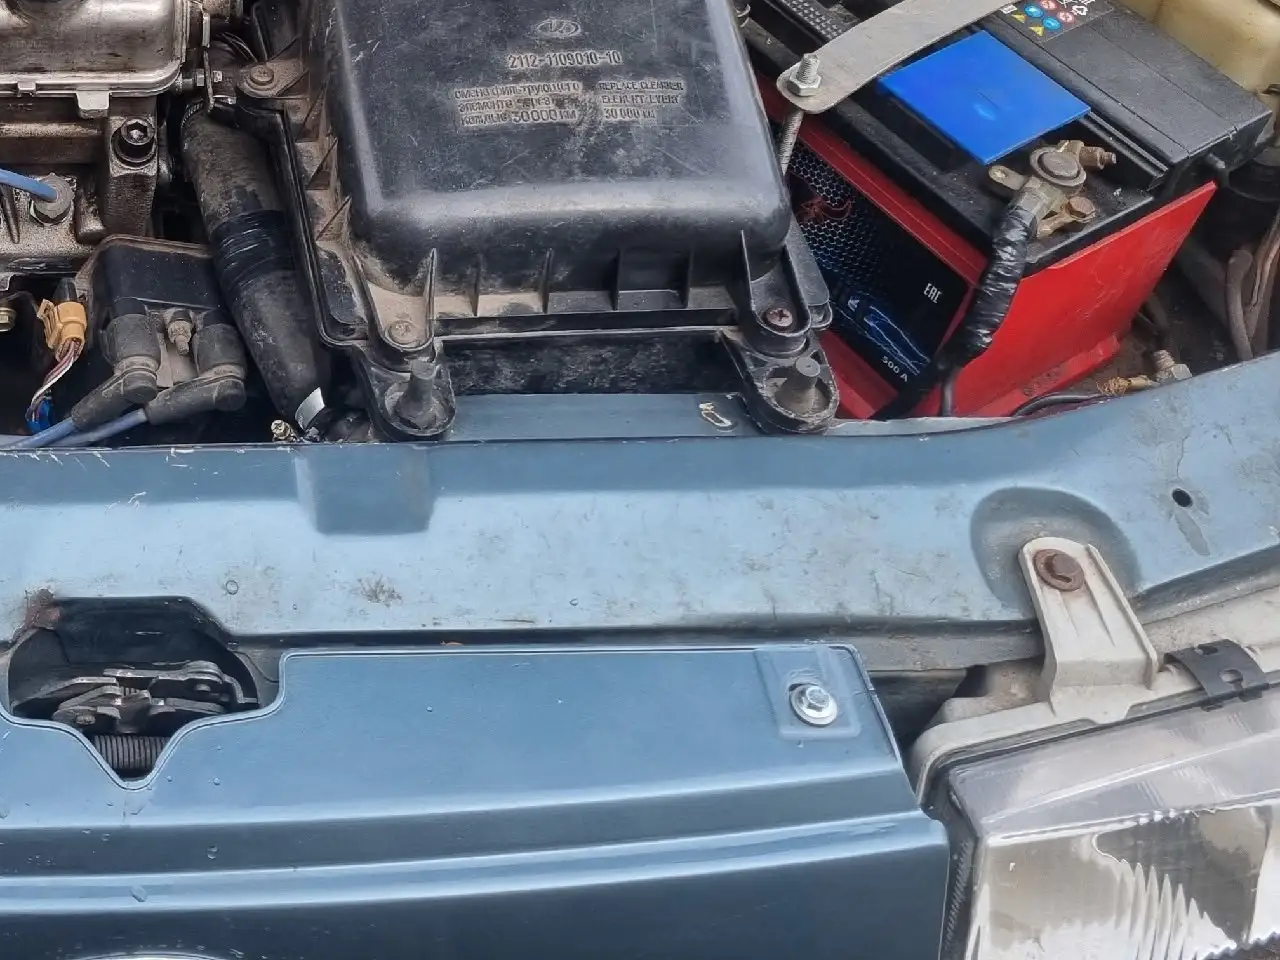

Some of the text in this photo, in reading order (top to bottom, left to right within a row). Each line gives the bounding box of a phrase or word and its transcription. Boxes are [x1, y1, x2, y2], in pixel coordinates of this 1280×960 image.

[508, 50, 622, 69] 2112-1109010-10
[882, 355, 908, 383] 500 A
